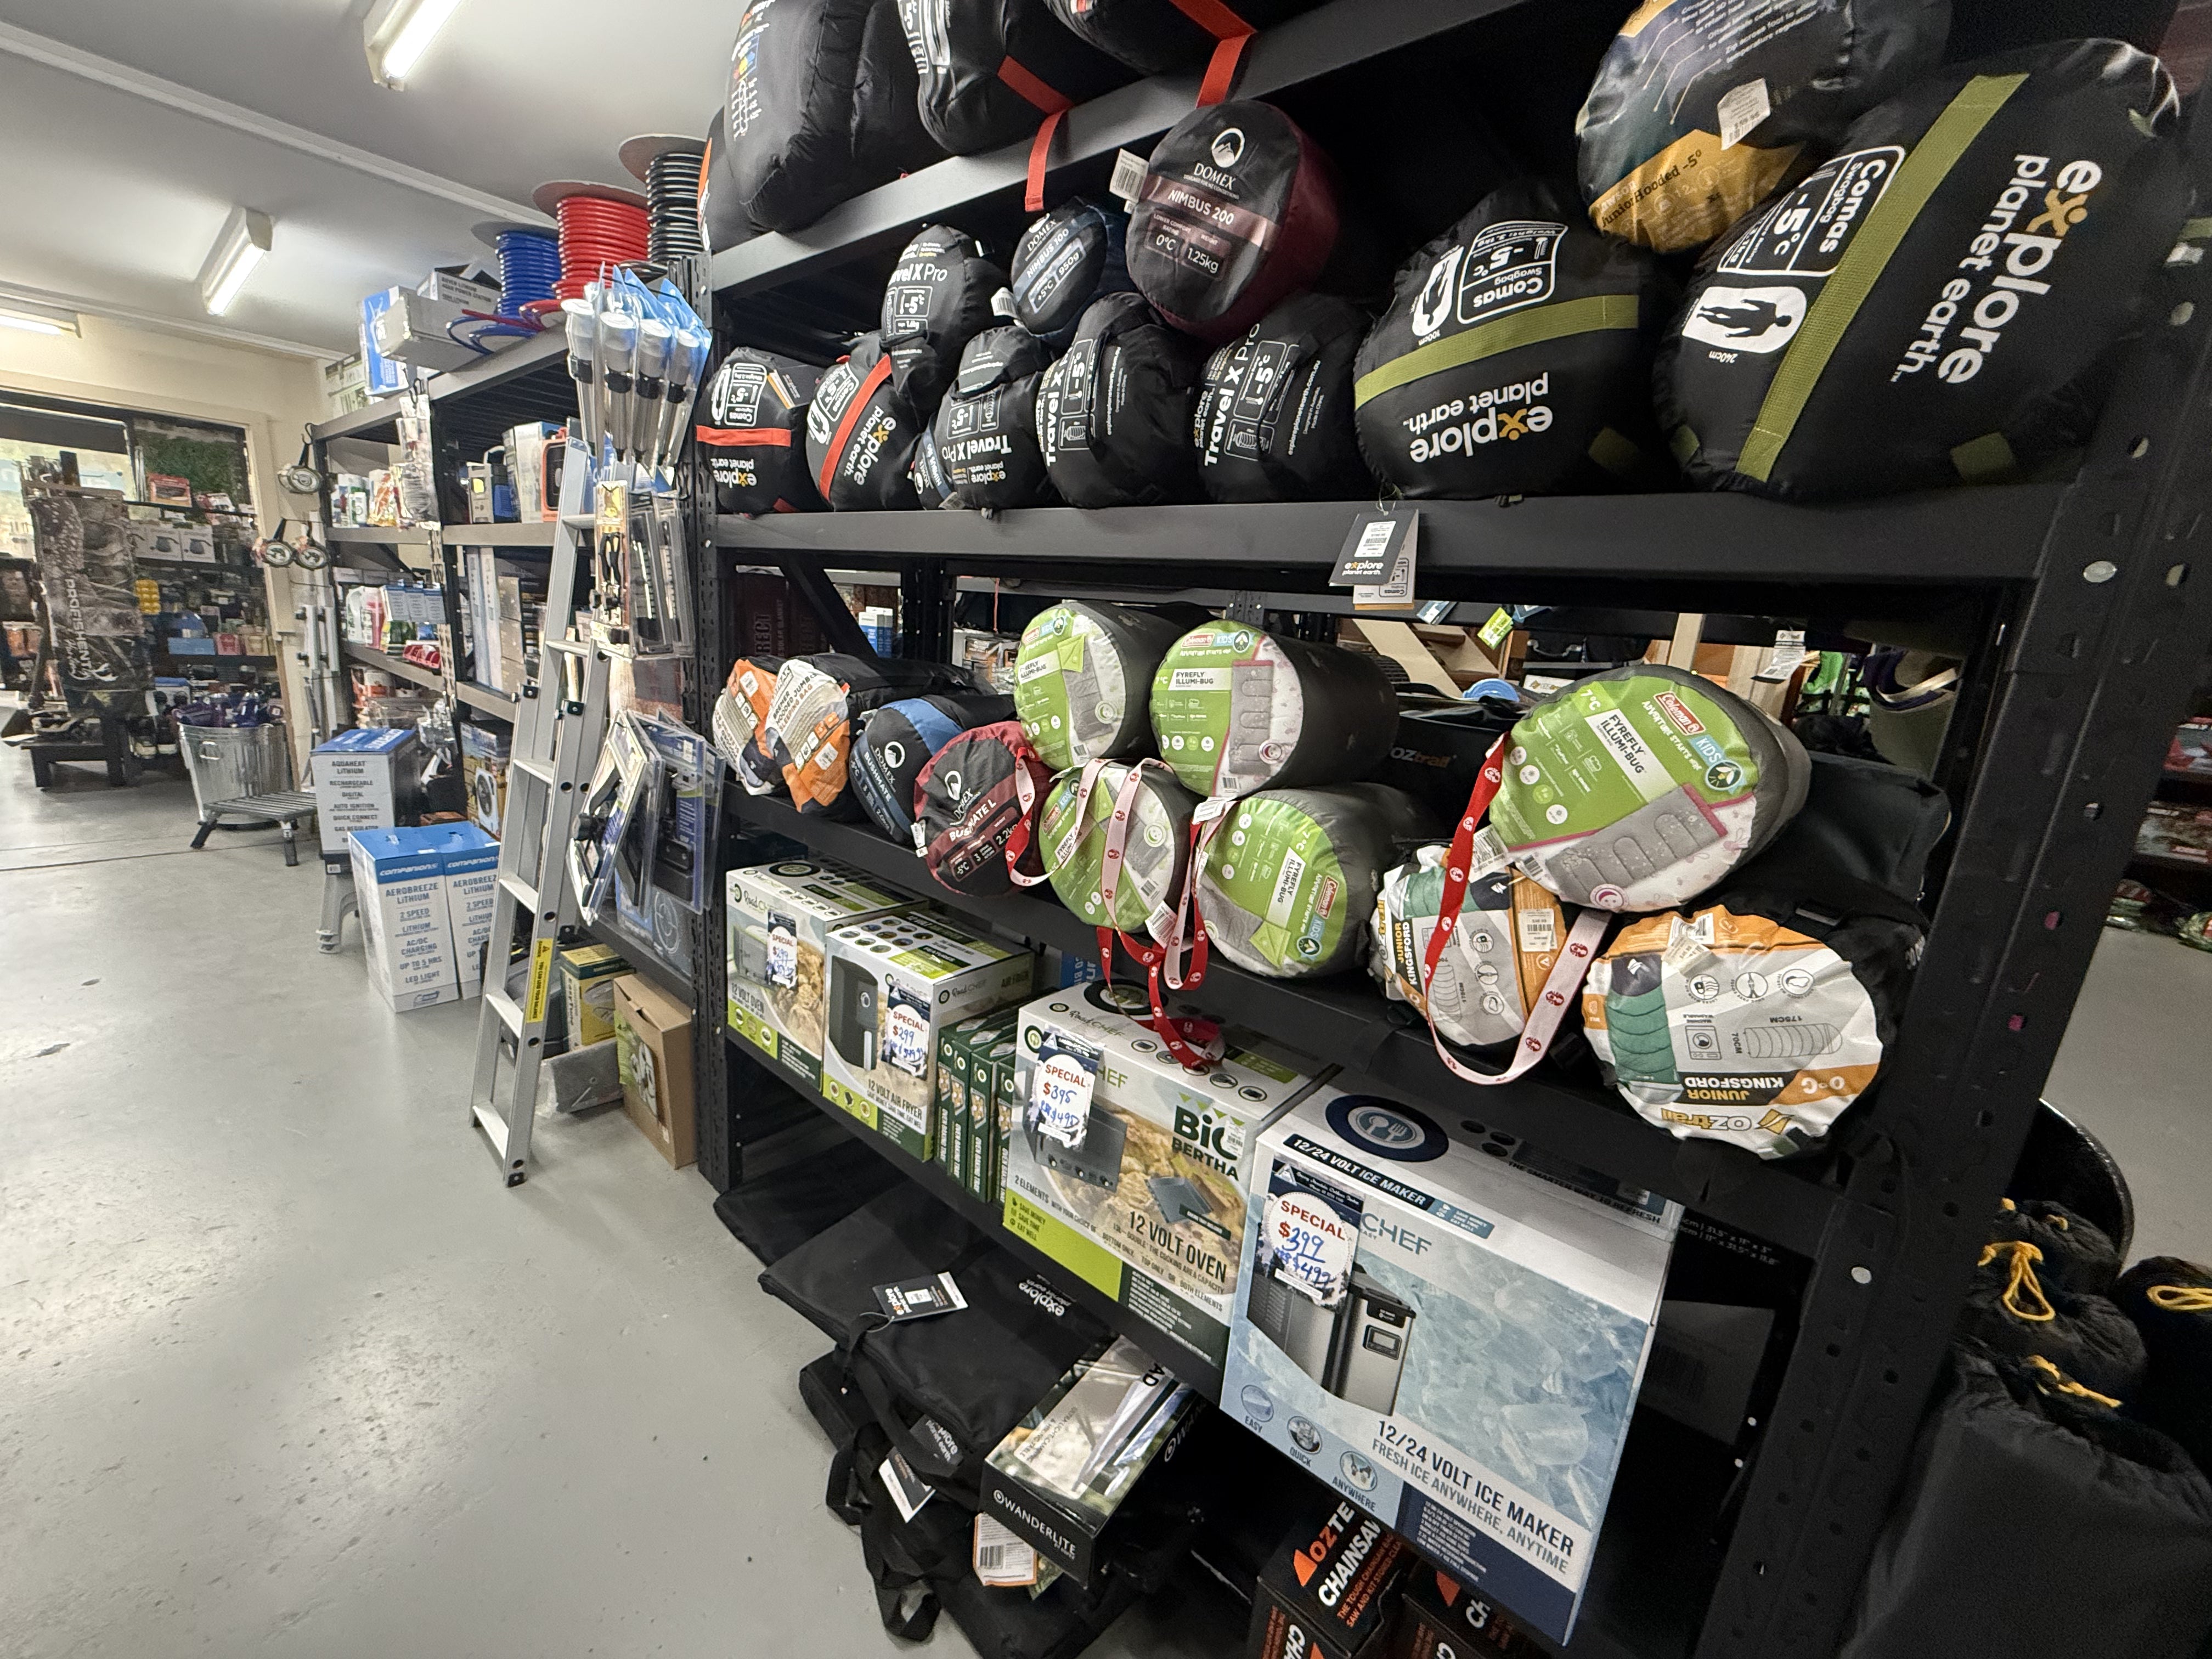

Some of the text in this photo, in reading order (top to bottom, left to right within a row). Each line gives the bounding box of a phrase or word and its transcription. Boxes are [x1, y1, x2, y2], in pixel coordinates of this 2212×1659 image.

[1194, 162, 1237, 190] DOMEX
[1819, 161, 1864, 224] Swagbag
[1168, 189, 1234, 225] NIMBUS 200
[1818, 157, 1888, 255] Comas
[1957, 153, 2050, 273] planet
[1026, 219, 1057, 252] DOMEX
[1155, 234, 1176, 251] 0°C
[1026, 243, 1054, 279] NIMBUS
[1053, 228, 1069, 247] 100
[1058, 251, 1080, 276] 950g
[1187, 247, 1219, 274] 1.25kg
[924, 263, 948, 282] Pro
[1493, 267, 1543, 286] Swagbag
[1937, 157, 2103, 385] explore
[1472, 276, 1544, 309] Comas
[1418, 329, 1441, 346] 100cm
[1708, 350, 1739, 364] 240cm
[1204, 323, 1260, 466] Travel X Pro
[1469, 371, 1549, 414] planet
[857, 405, 884, 445] planet
[1046, 391, 1059, 467] Travel
[1194, 390, 1208, 448] explore
[1409, 404, 1554, 464] explore
[854, 416, 896, 485] explore
[966, 435, 1012, 460] Travel
[713, 469, 757, 488] explore
[730, 458, 754, 472] planet
[971, 470, 1006, 484] explore
[1345, 560, 1384, 569] explore
[65, 579, 92, 669] PROFISHENT
[799, 684, 813, 699] BAG
[776, 697, 794, 725] HOODED
[1641, 701, 1672, 737] ADVENTURE
[1609, 713, 1646, 756] FYREFLY
[1661, 693, 1723, 764] Coleman KIDS
[1600, 720, 1646, 774] ILLUMI-BUG
[864, 751, 892, 803] BUSHMATE
[874, 748, 896, 784] DOMEX
[386, 882, 438, 897] AEROBREEZE
[453, 874, 497, 888] AEROBREEZ
[1277, 859, 1295, 903] ILLUMI-BUG
[1288, 862, 1302, 897] FYREFLY
[407, 908, 430, 917] SPEED
[1310, 920, 1323, 938] KIDS
[401, 943, 437, 956] CHARGING
[772, 934, 794, 947] SPECIAL
[1395, 922, 1404, 963] JUNIOR
[1402, 922, 1418, 985] KINGSFORD
[893, 1011, 924, 1032] SPECIAL
[1068, 1009, 1126, 1037] Road CHEF
[1731, 1032, 1742, 1054] 70CM
[1045, 1064, 1087, 1088] SPECIAL
[1684, 1076, 1785, 1089] KINGSFORD
[1801, 1075, 1846, 1094] 0°C
[867, 1079, 875, 1091] 12
[890, 1092, 901, 1106] AIR
[901, 1098, 922, 1120] FRYER
[1686, 1090, 1751, 1101] JUNIOR
[1661, 1108, 1752, 1131] OZtrail
[1172, 1136, 1240, 1182] BERTHA
[1293, 1139, 1329, 1162] 12/24
[1330, 1154, 1361, 1176] VOLT
[1359, 1169, 1379, 1185] ICE
[1380, 1178, 1427, 1206] MAKER
[1508, 1160, 1527, 1172] THE
[1528, 1167, 1572, 1189] SMARTER
[1015, 1175, 1051, 1204] 2 ELEMENTS
[1280, 1200, 1346, 1241] SPECIAL
[1361, 1212, 1432, 1255] CHEF
[1129, 1211, 1228, 1283] 12 VOLT OVEN
[1018, 1282, 1065, 1317] explore
[1194, 1288, 1223, 1312] ELEMENTS
[1244, 1414, 1263, 1434] EASY
[1289, 1446, 1312, 1468] QUICK
[1331, 1475, 1378, 1513] ANYWHERE
[1378, 1420, 1429, 1464] 12/24
[1431, 1451, 1475, 1489] VOLT
[1475, 1479, 1504, 1512] ICE
[1506, 1501, 1575, 1558] MAKER
[1372, 1438, 1570, 1575] FRESH ICE ANYTIME
[1003, 1495, 1077, 1555] WANDERLITE
